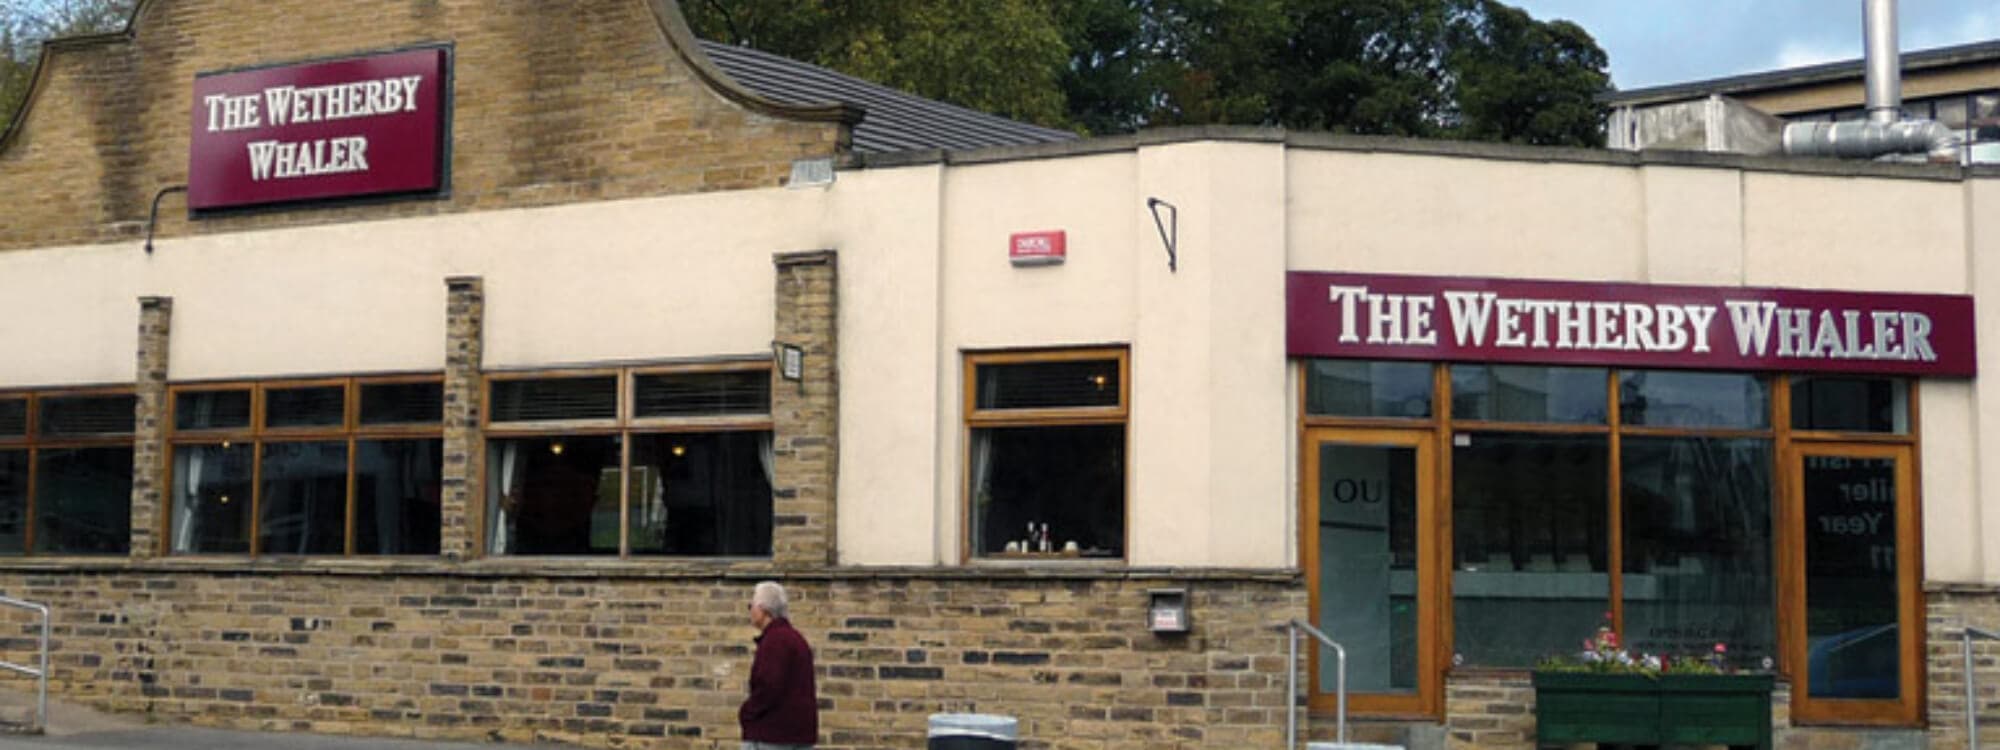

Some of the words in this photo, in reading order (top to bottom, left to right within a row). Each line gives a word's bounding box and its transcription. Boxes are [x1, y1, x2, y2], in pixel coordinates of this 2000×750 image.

[204, 94, 261, 131] THE
[264, 75, 422, 126] WETHERBY
[247, 136, 369, 181] WHALER
[1329, 285, 1438, 345] THE
[1443, 291, 1717, 352] WETHERBY
[1725, 299, 1938, 362] WHALER
